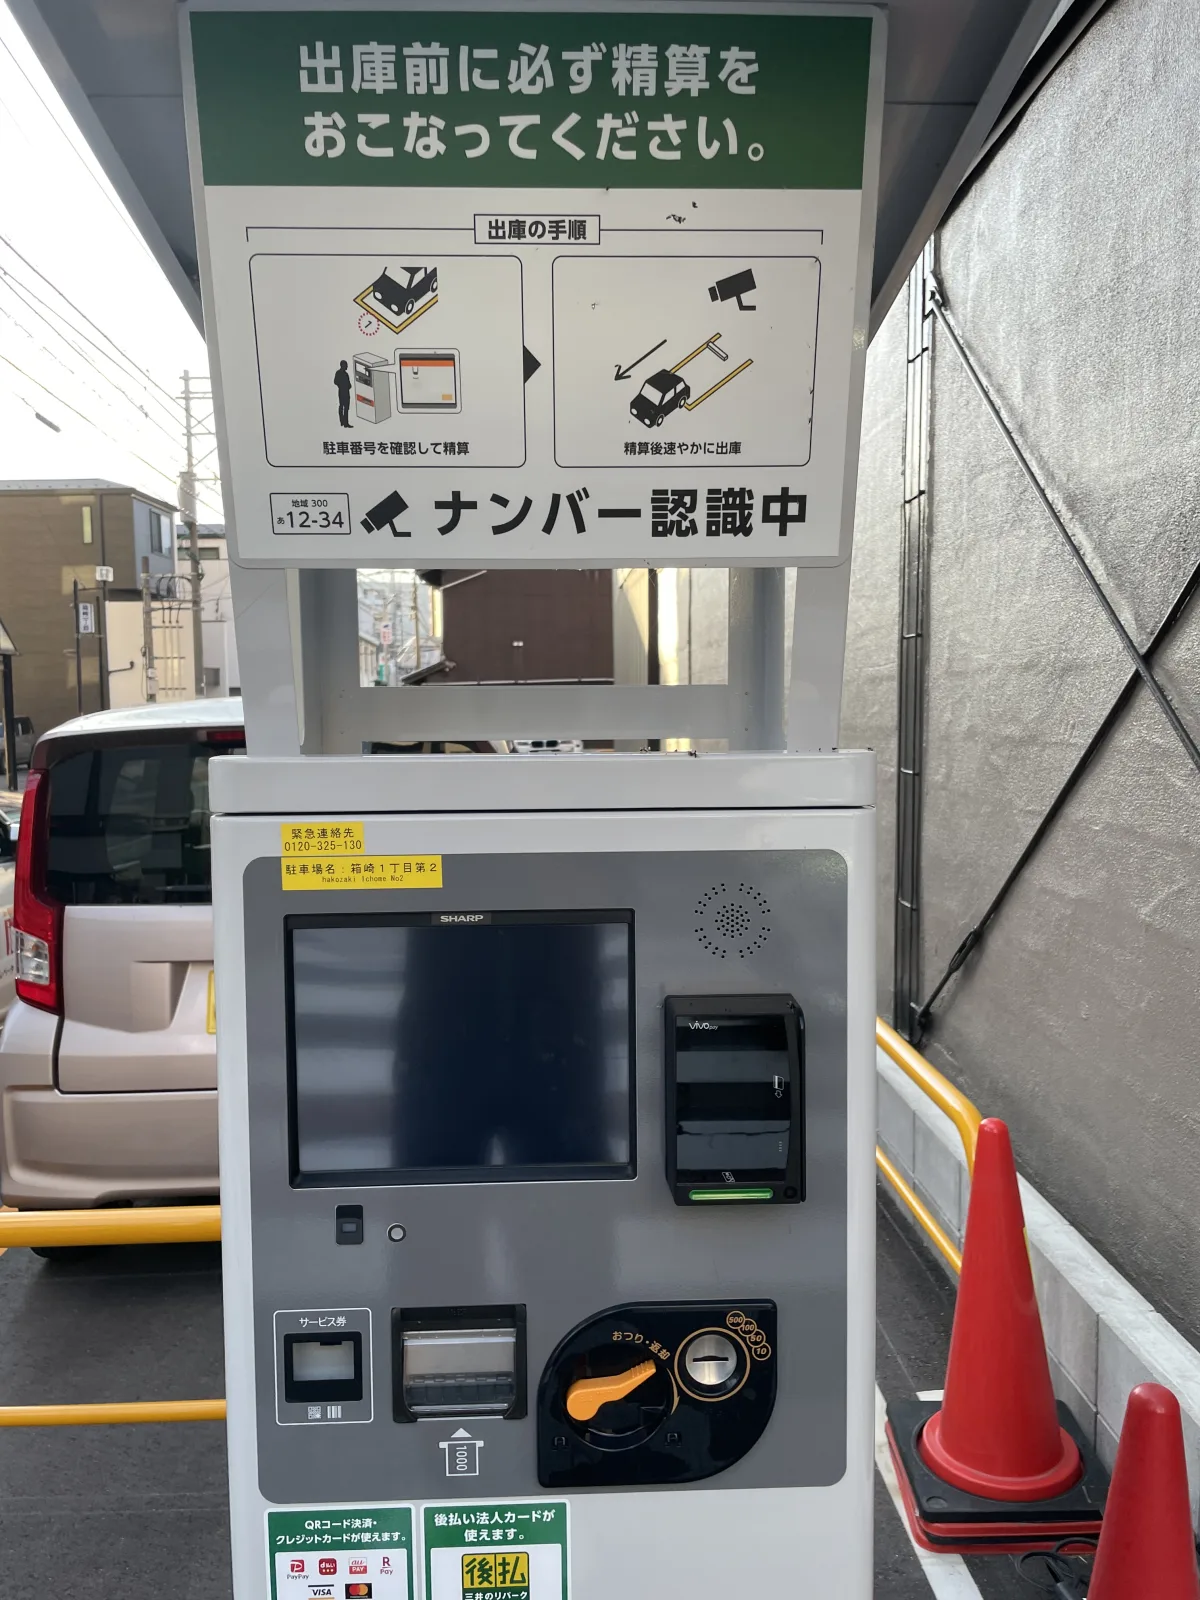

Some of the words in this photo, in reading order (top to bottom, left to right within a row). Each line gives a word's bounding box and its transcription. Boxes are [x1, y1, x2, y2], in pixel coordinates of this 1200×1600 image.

[299, 41, 759, 97] 出庫前に必ず精算を
[303, 110, 765, 162] おこなってください。
[487, 218, 587, 241] 出庫の手順
[322, 441, 470, 456] 駐車番号を確認して精算
[623, 441, 742, 456] 精算後速やかに出庫
[291, 499, 309, 508] 地域
[311, 499, 328, 508] 300
[434, 486, 808, 538] ナンバー認識中
[276, 516, 285, 525] あ
[286, 510, 345, 529] 12-34
[291, 828, 355, 840] 緊急連絡先
[284, 839, 362, 852] 0120-325-130
[440, 914, 484, 923] SHARP
[299, 1316, 347, 1328] サービス券
[728, 1315, 744, 1325] 500
[741, 1322, 756, 1332] 100
[750, 1333, 763, 1343] 50
[612, 1331, 671, 1360] おつり・返却
[756, 1346, 768, 1356] 10
[456, 1445, 468, 1472] 1000
[433, 1509, 556, 1527] 後払い法人カードが
[275, 1532, 407, 1545] クレジットカードが使えます。
[464, 1528, 525, 1542] 使えます。
[382, 1556, 391, 1567] R
[379, 1568, 394, 1576] Pay
[465, 1556, 526, 1586] 後払
[312, 1588, 332, 1596] VISA
